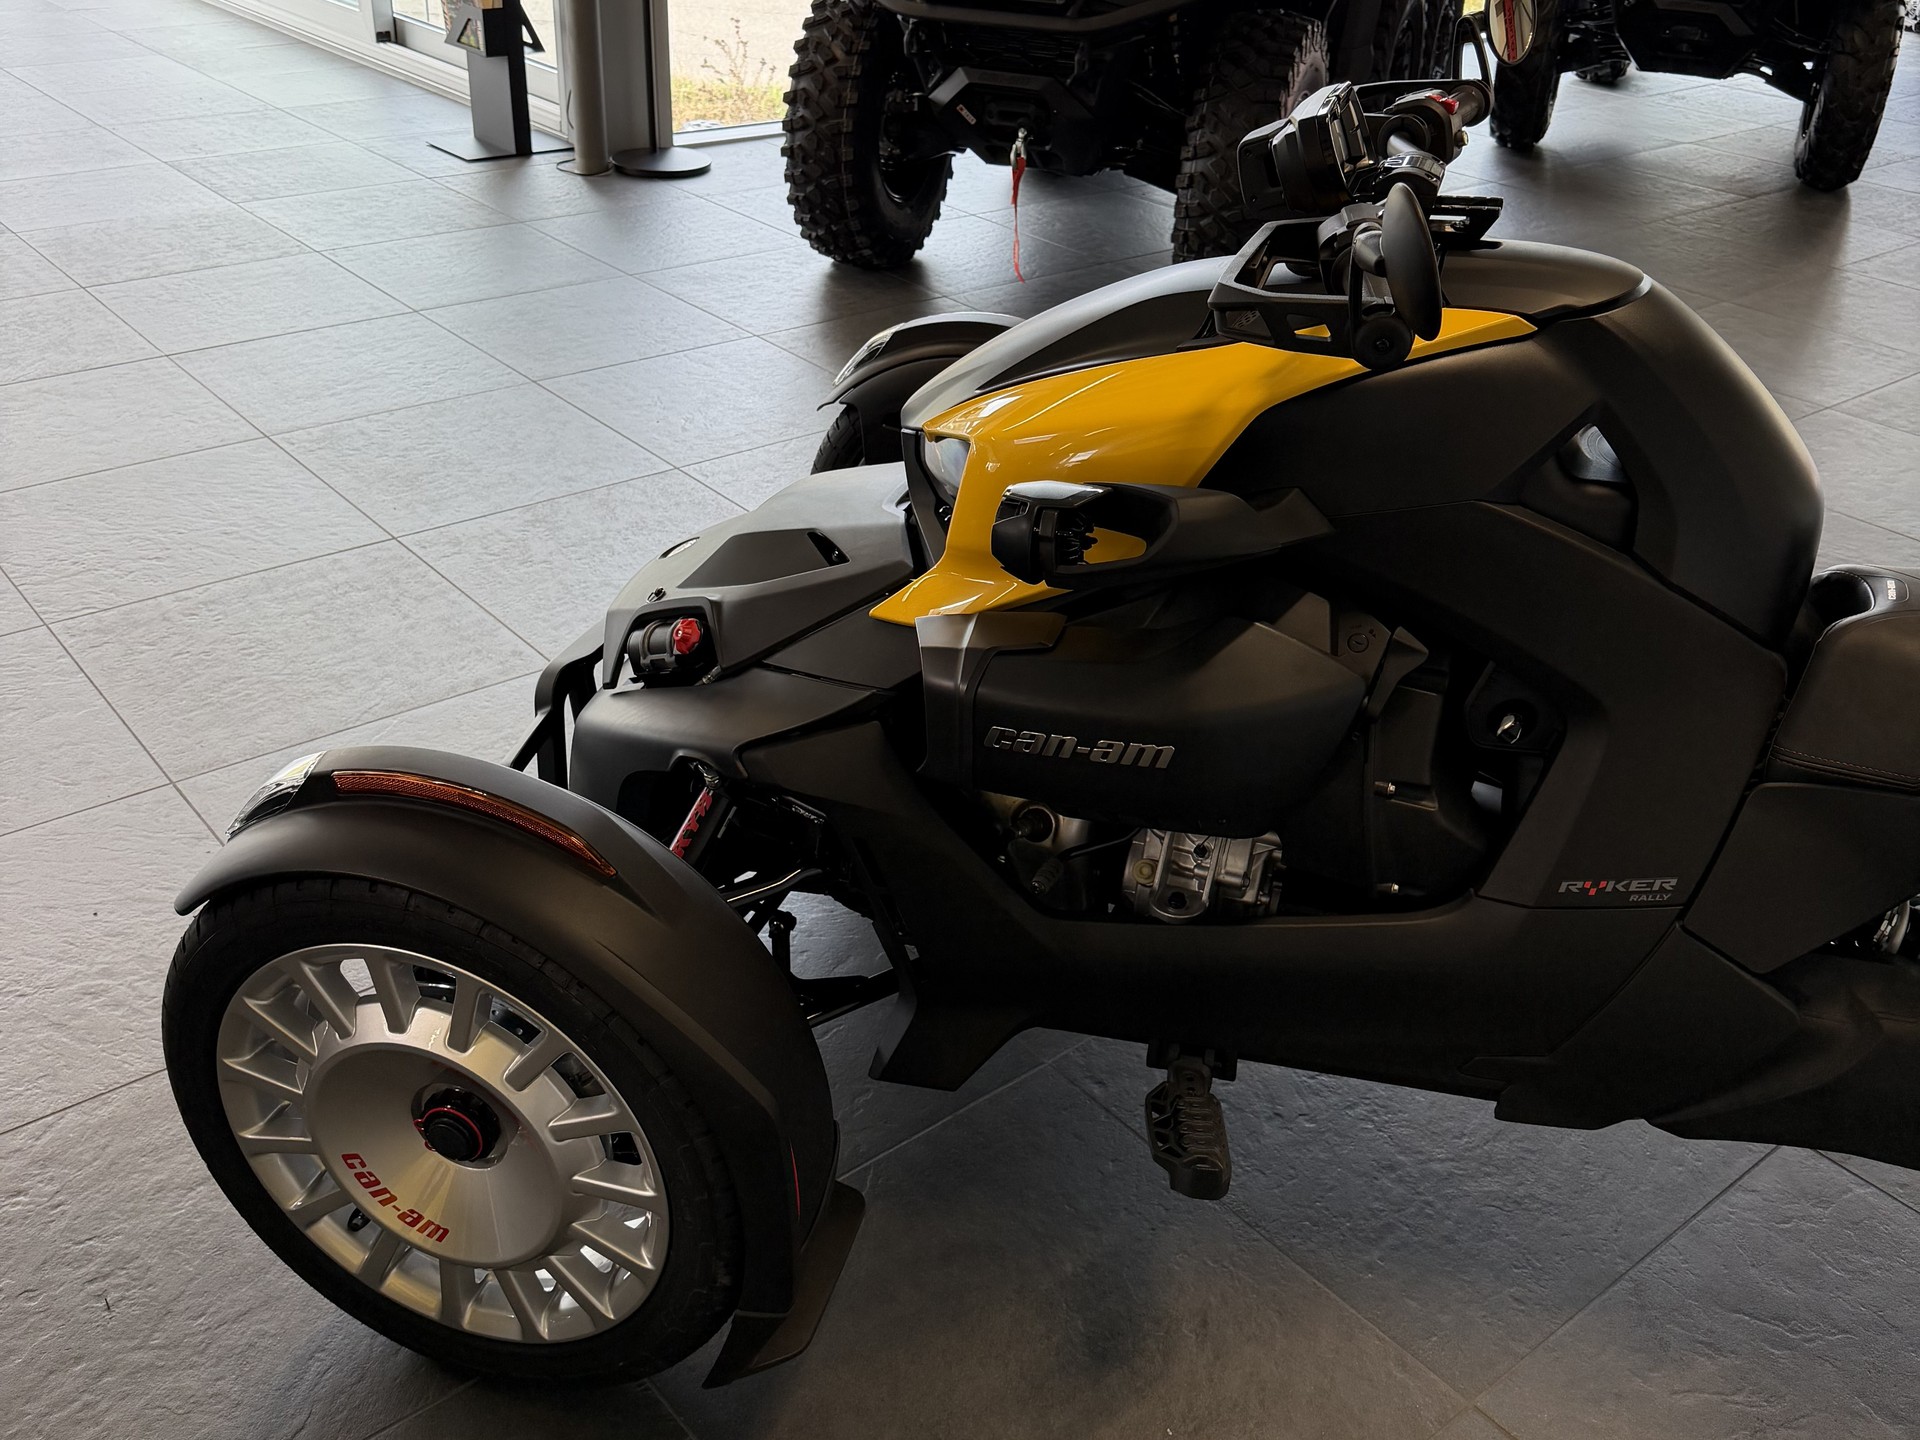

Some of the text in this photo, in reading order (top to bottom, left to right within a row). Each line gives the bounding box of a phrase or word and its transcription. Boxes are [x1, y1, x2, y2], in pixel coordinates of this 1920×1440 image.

[984, 725, 1175, 769] can-am
[1558, 878, 1678, 896] RYKER
[1629, 893, 1671, 902] RALLY
[341, 1153, 450, 1243] can-am
